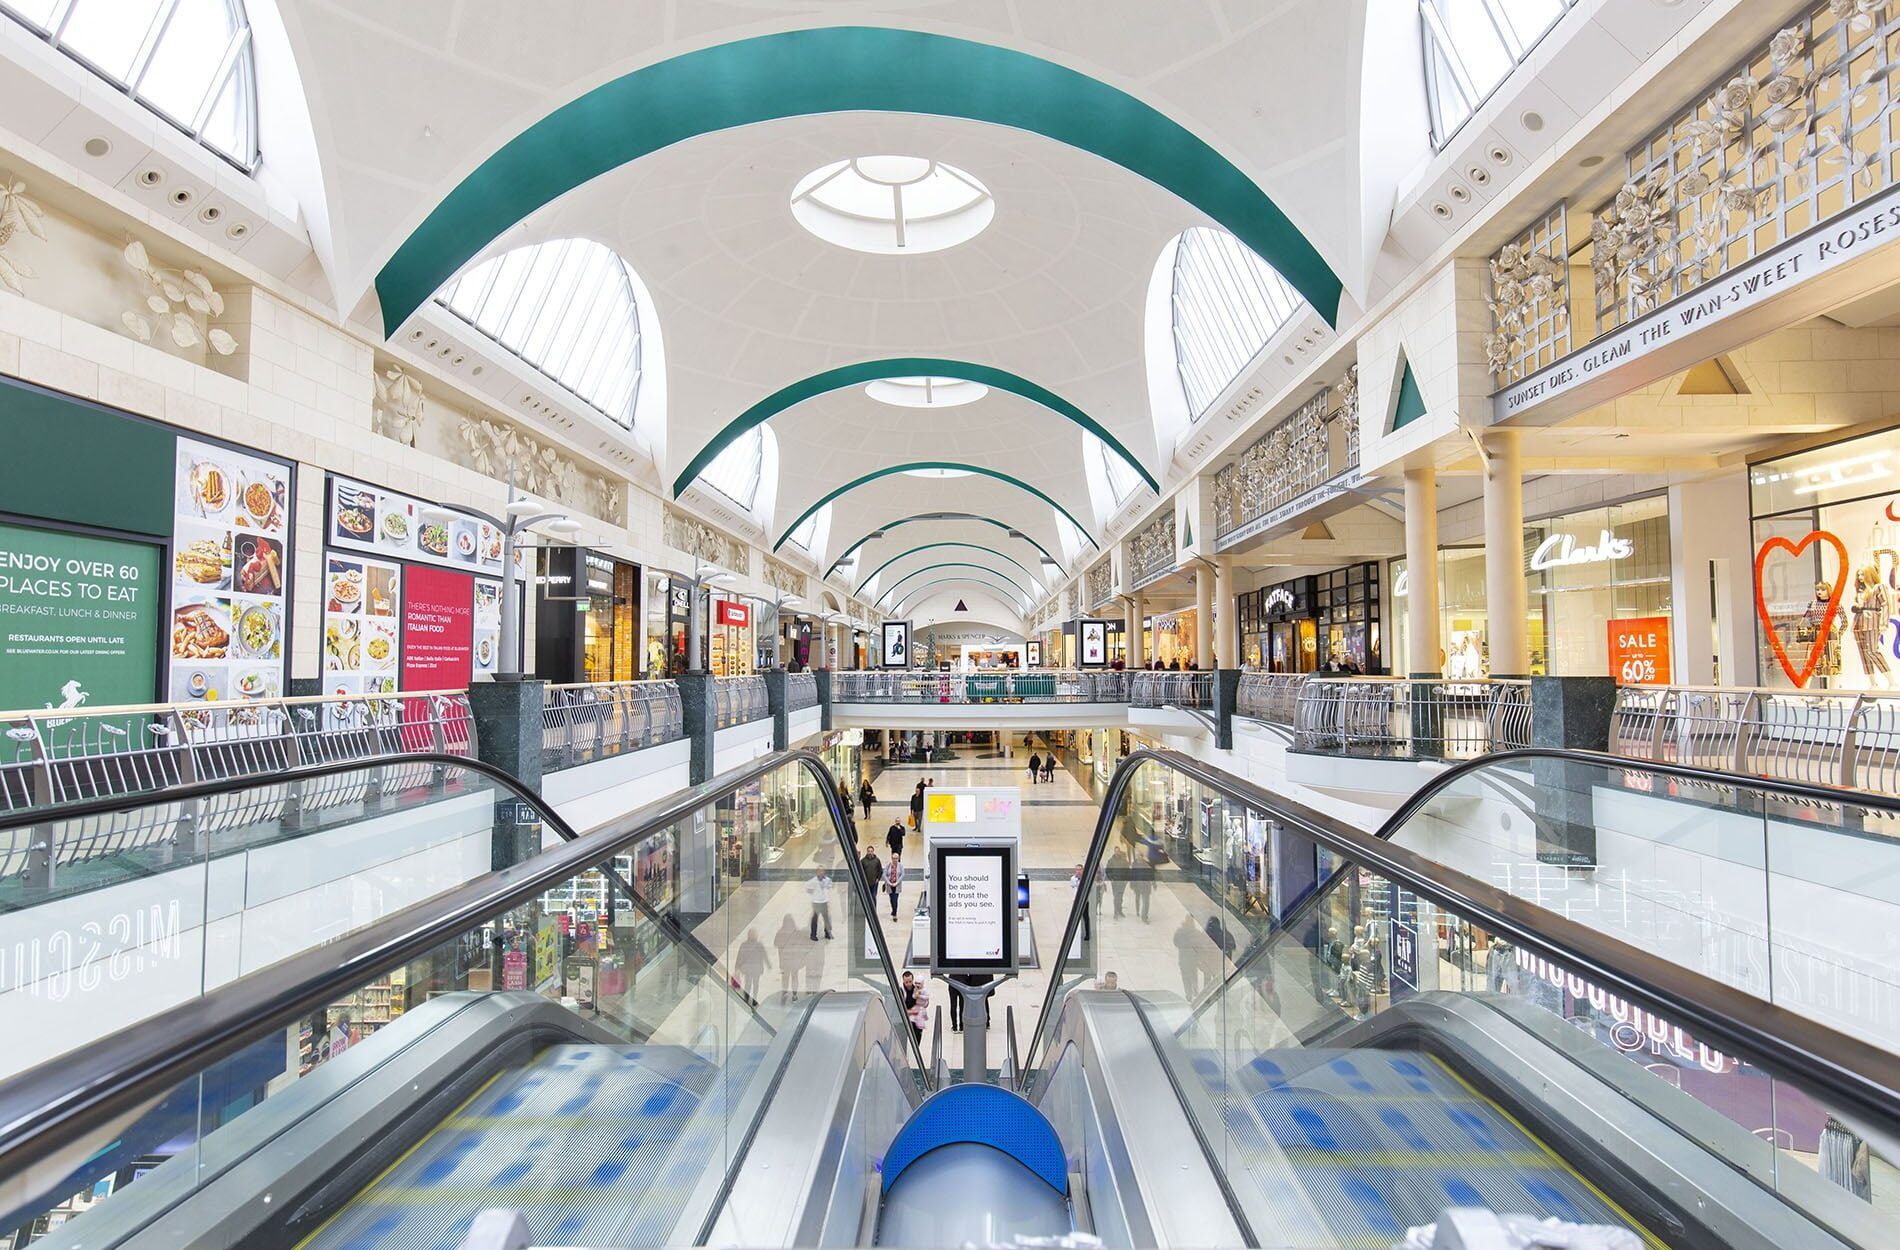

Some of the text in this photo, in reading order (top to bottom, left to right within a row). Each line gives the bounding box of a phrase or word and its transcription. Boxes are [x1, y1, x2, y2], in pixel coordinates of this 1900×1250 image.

[1508, 381, 1546, 408] SUNSET
[1583, 340, 1631, 372] GLEAM
[1639, 321, 1671, 345] THE
[1680, 254, 1803, 325] WAN-SWEET
[1531, 529, 1634, 571] Clarks
[0, 551, 139, 580] ENJOY OVER 60
[0, 575, 139, 602] PLACES TO EAT
[408, 601, 430, 612] THERE'S
[431, 604, 454, 615] NOTHING
[1265, 588, 1294, 613] FATFACE
[59, 607, 92, 618] LUNCH
[94, 610, 100, 618] &
[102, 610, 137, 620] DINNER
[407, 612, 452, 624] ROMANTIC THAN
[407, 623, 444, 633] ITALIAN FOOD
[8, 634, 64, 643] RESTAURANTS
[65, 635, 86, 644] OPEN
[87, 636, 108, 644] UNTIL
[1619, 633, 1656, 648] SALE
[1622, 660, 1655, 681] 60%
[1396, 934, 1412, 963] GAP
